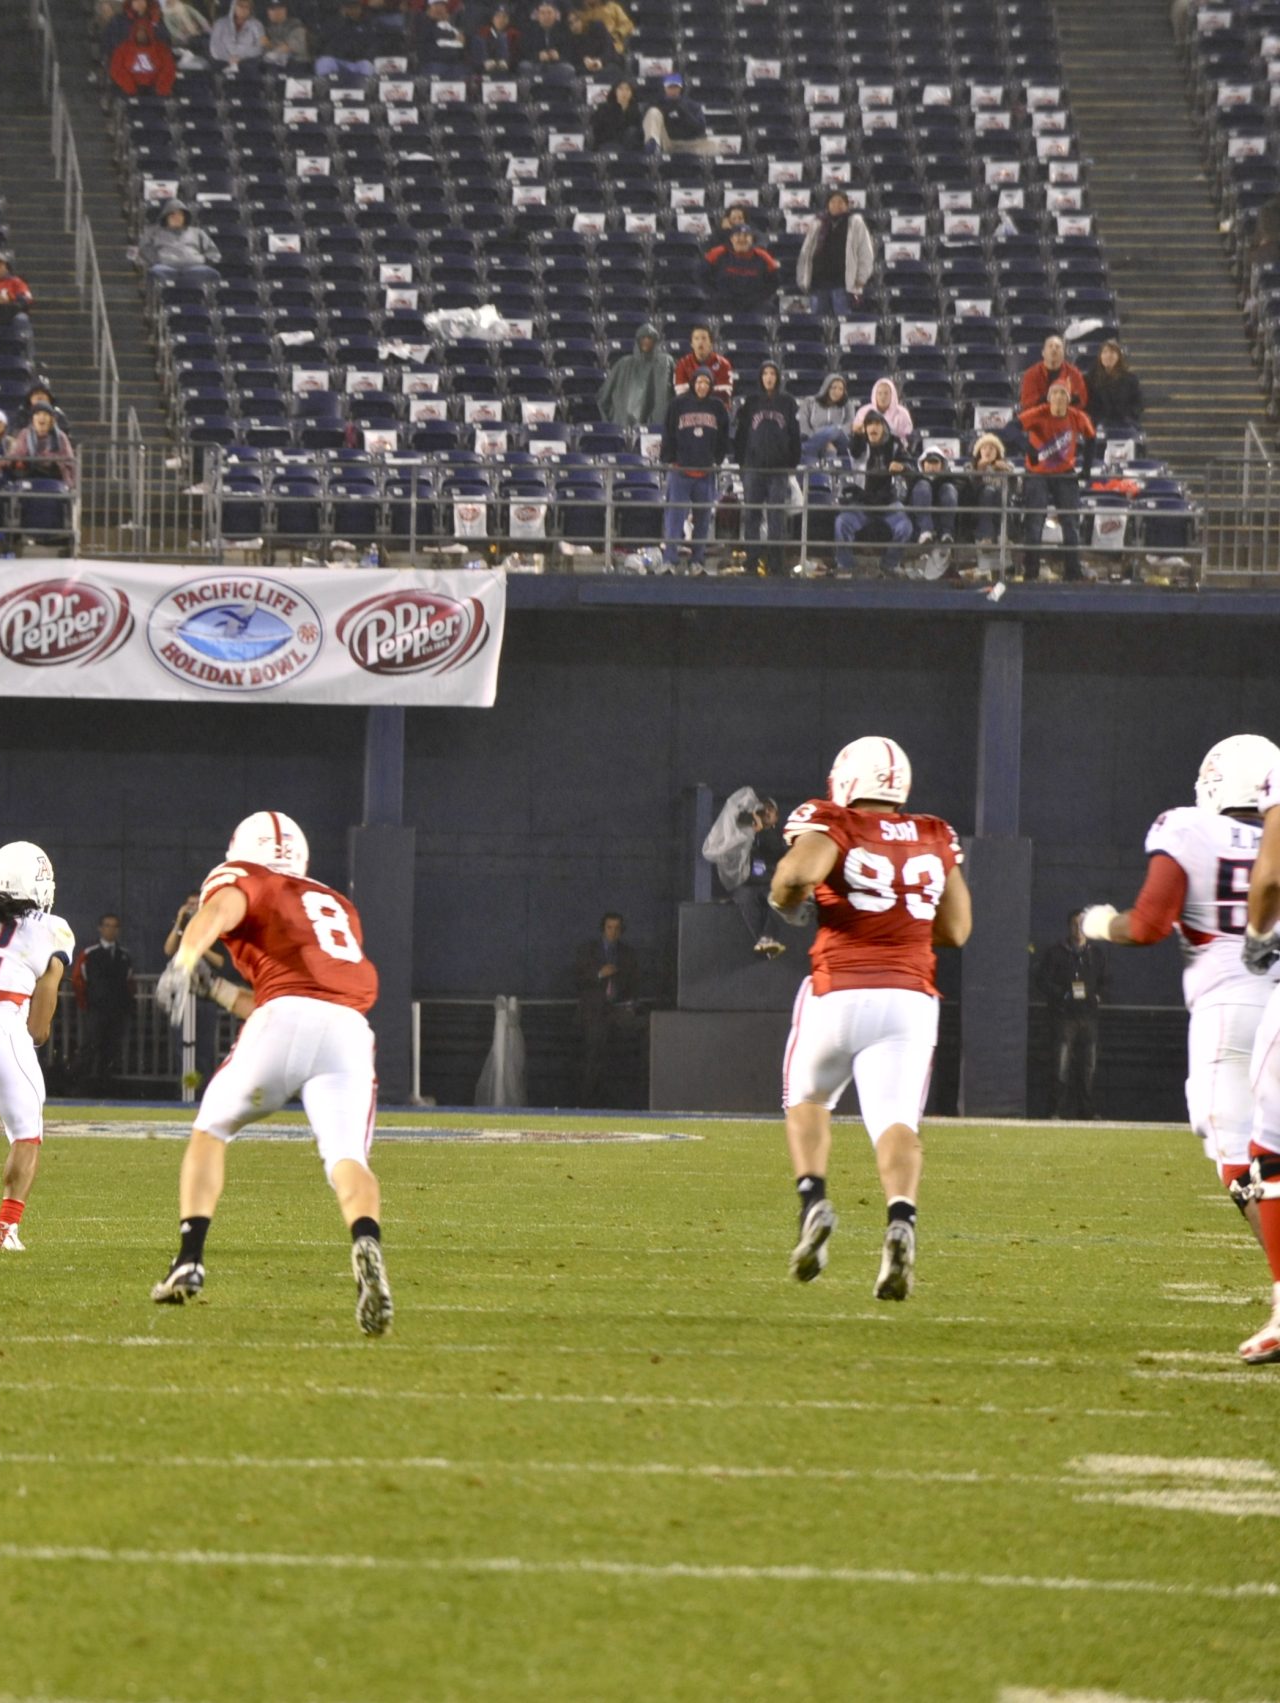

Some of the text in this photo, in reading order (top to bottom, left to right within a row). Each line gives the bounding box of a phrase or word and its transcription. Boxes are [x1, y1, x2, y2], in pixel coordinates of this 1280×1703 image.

[40, 592, 80, 624] Dr
[172, 581, 299, 617] PACIFIC LIFE
[395, 602, 435, 634] Dr
[0, 601, 106, 656] Pepper
[353, 609, 461, 666] Pepper
[159, 641, 308, 686] HOLIDAY BOWL
[879, 820, 919, 841] SUH
[36, 856, 52, 881] A
[843, 846, 946, 920] 93
[301, 890, 363, 964] 8
